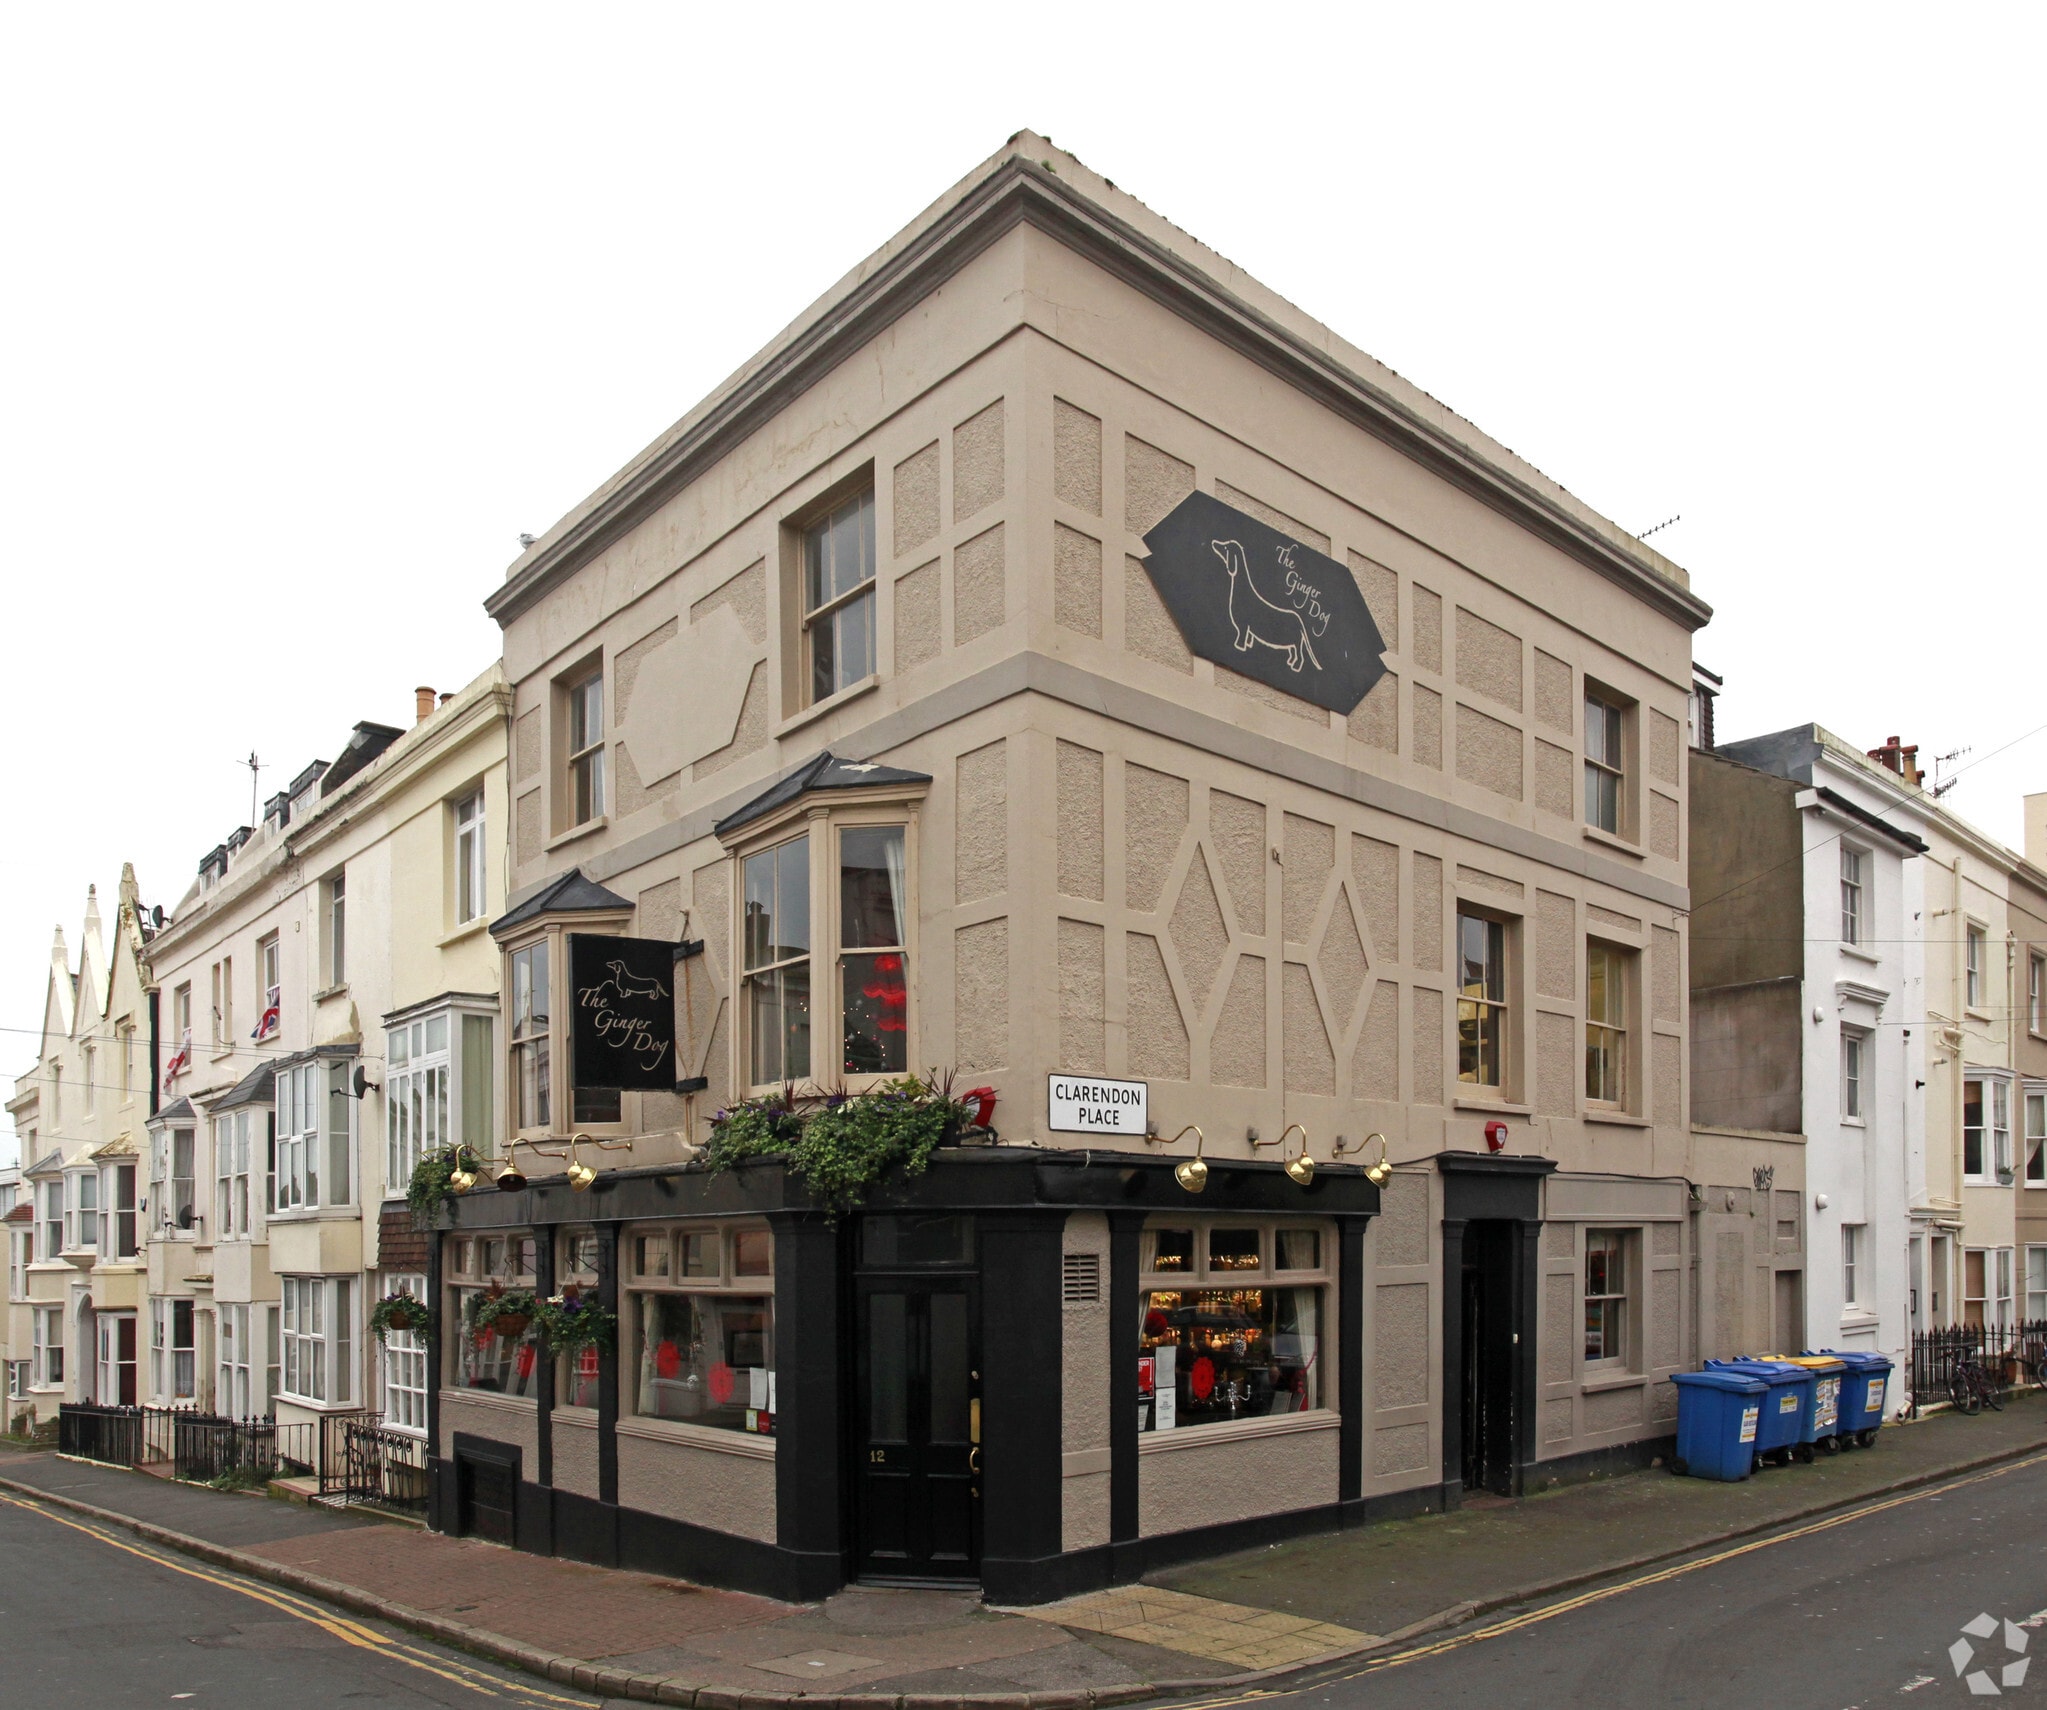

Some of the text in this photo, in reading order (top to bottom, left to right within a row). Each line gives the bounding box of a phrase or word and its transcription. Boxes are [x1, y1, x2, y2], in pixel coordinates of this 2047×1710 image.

[1276, 544, 1299, 569] The
[1285, 571, 1321, 609] Ginger
[1308, 600, 1331, 637] Dog
[578, 980, 614, 1008] The
[594, 1010, 652, 1047] Ginger
[633, 1033, 669, 1071] Dog
[1056, 1083, 1141, 1106] CLARENDON
[1079, 1107, 1120, 1126] PLACE
[870, 1449, 885, 1463] 12
